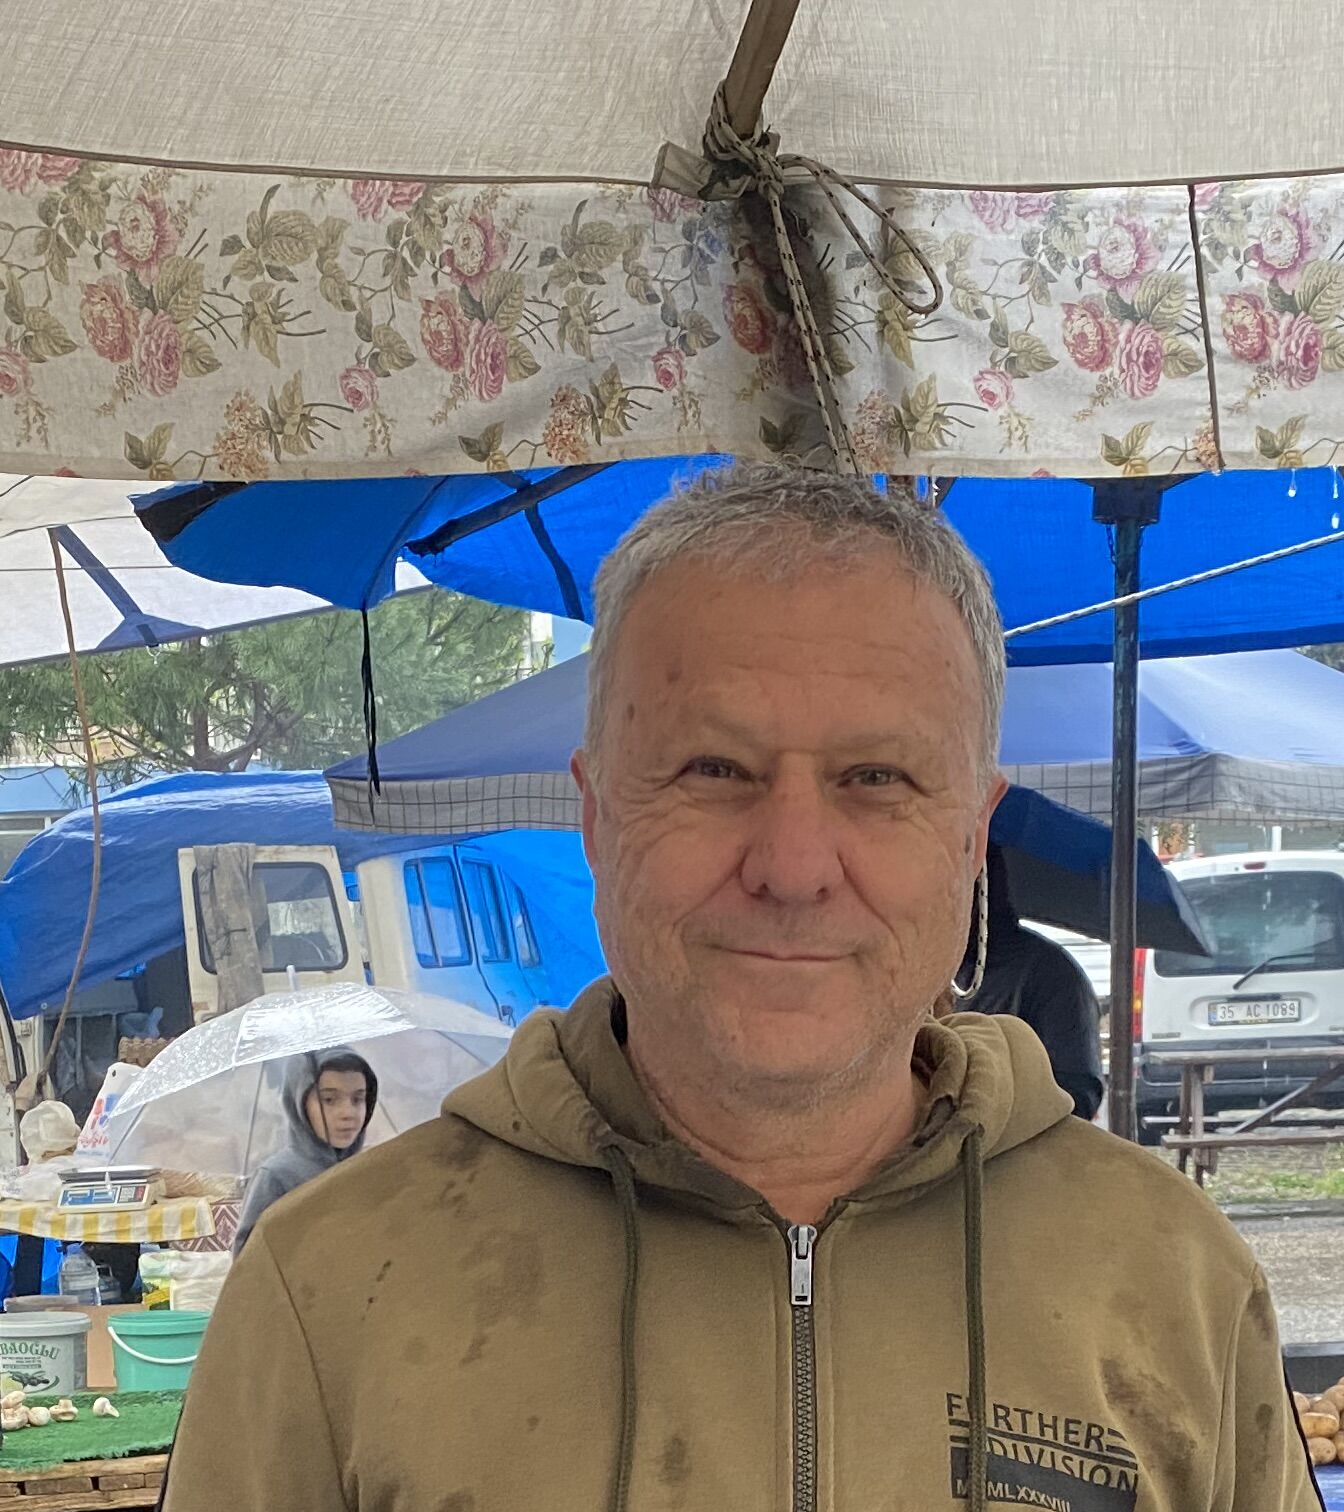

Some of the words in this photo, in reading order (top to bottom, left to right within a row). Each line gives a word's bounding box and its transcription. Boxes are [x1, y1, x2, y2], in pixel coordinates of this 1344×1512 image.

[1219, 1004, 1235, 1020] 35
[1246, 1002, 1261, 1018] AC
[1266, 1002, 1296, 1017] 1089
[946, 1392, 1105, 1452] FRTHER
